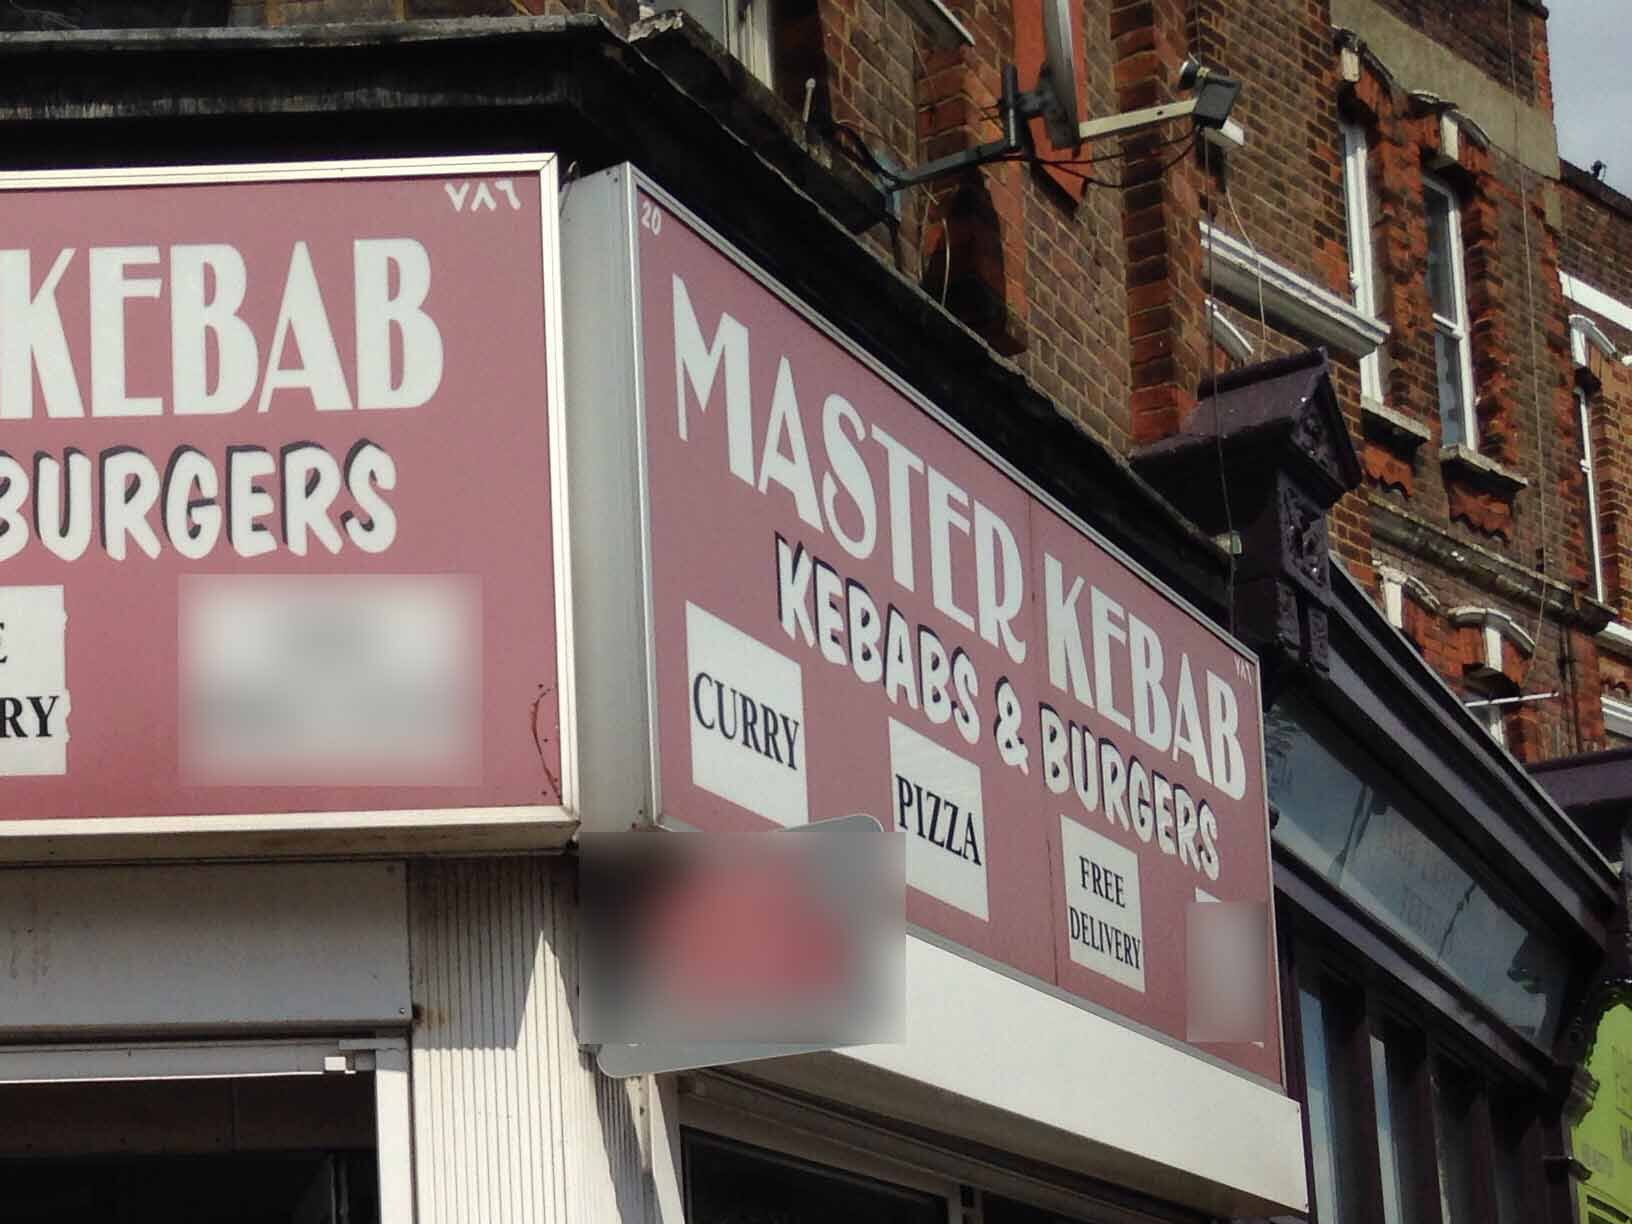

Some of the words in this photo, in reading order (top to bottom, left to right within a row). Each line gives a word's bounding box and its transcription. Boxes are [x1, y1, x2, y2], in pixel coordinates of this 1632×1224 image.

[641, 199, 662, 236] 20
[672, 272, 1027, 667] MASTER
[1044, 551, 1246, 802] KEBAB
[692, 671, 800, 772] CURRY
[774, 531, 981, 745] KEBABS
[992, 676, 1030, 776] &
[1037, 700, 1220, 882] BURGERS
[896, 772, 982, 867] PIZZA
[1079, 854, 1126, 909] FREE
[1068, 906, 1142, 970] DELIVERY
